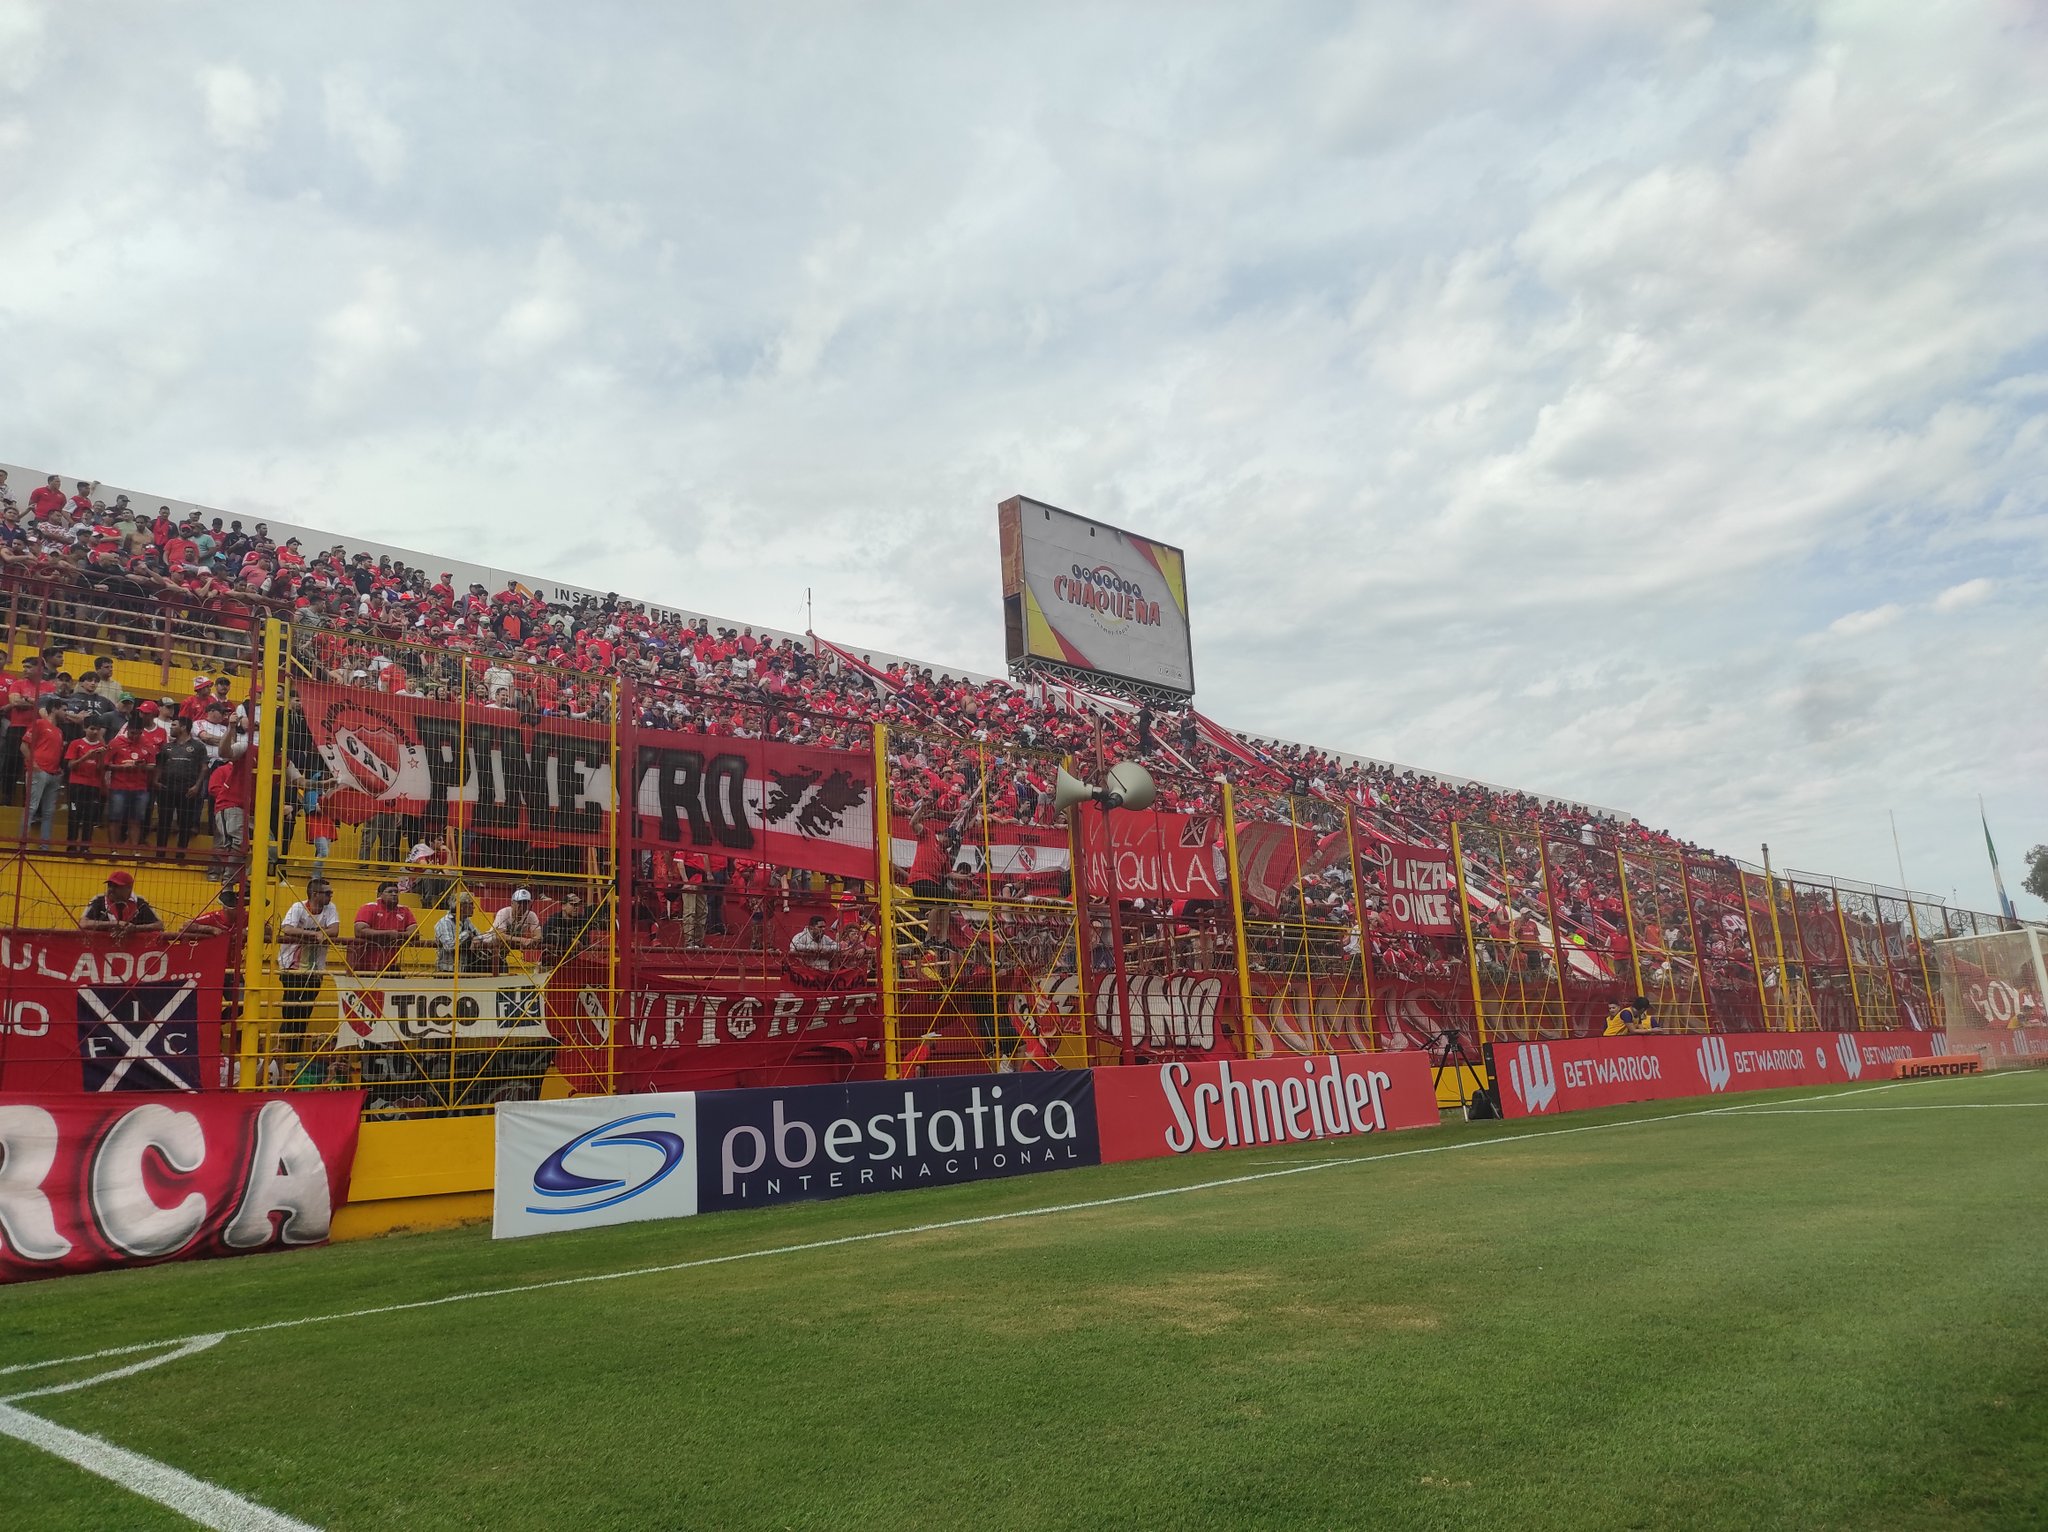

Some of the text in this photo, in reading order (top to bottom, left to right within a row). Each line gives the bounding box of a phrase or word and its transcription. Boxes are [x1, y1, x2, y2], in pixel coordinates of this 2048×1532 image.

[1392, 893, 1451, 925] ONCE
[391, 994, 480, 1038] TICO
[1563, 1055, 1662, 1088] BETWARRIOR
[1734, 1049, 1805, 1073] BETWARRIOR
[1160, 1055, 1391, 1153] Schneider
[721, 1085, 1078, 1195] pbestatica
[0, 1101, 331, 1260] RCA
[742, 1145, 1078, 1198] INTERNACIONAL
